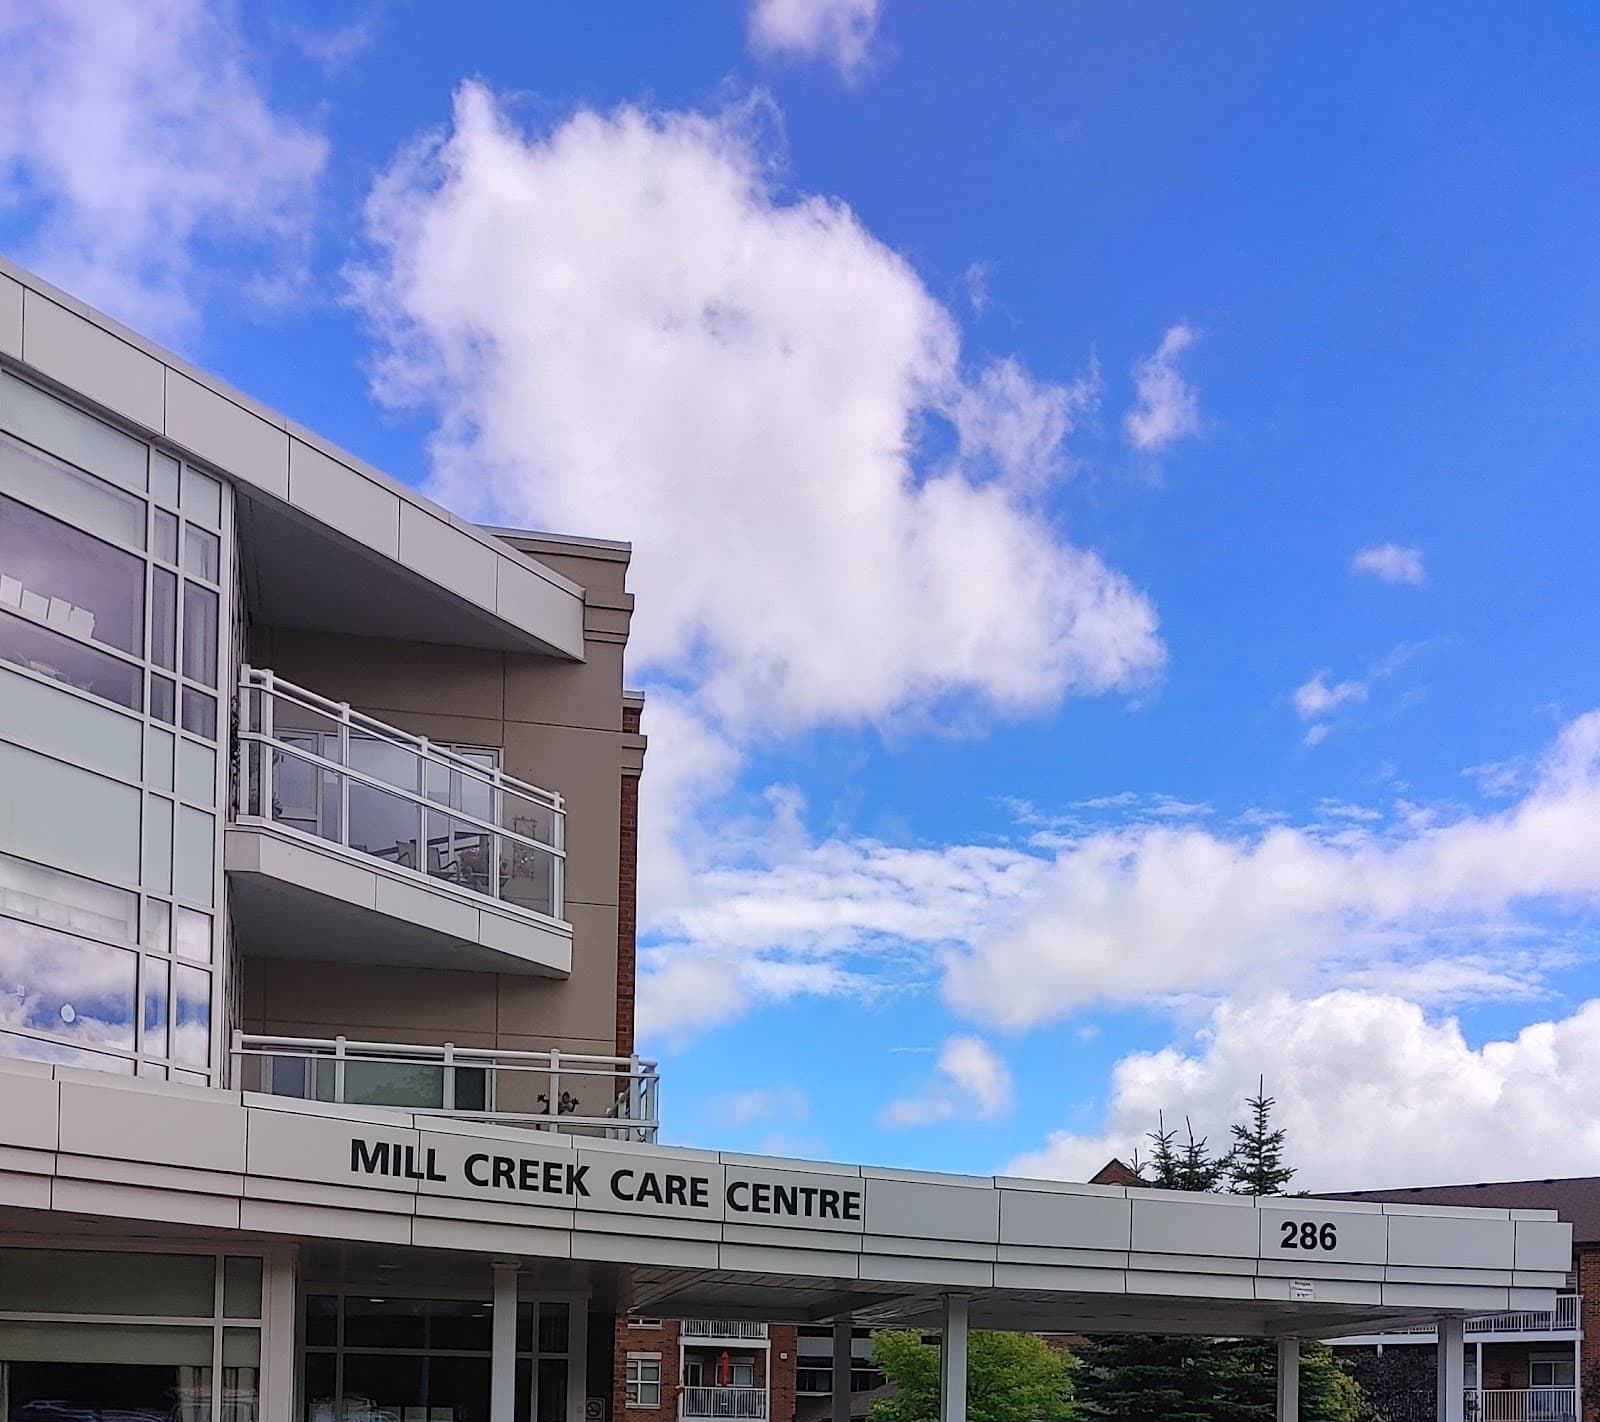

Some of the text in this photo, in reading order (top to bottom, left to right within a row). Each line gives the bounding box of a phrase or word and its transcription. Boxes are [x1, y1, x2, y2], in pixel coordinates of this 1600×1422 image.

[351, 1138, 861, 1221] MILL CREEK CARE CENTRE
[1280, 1221, 1337, 1250] 286
